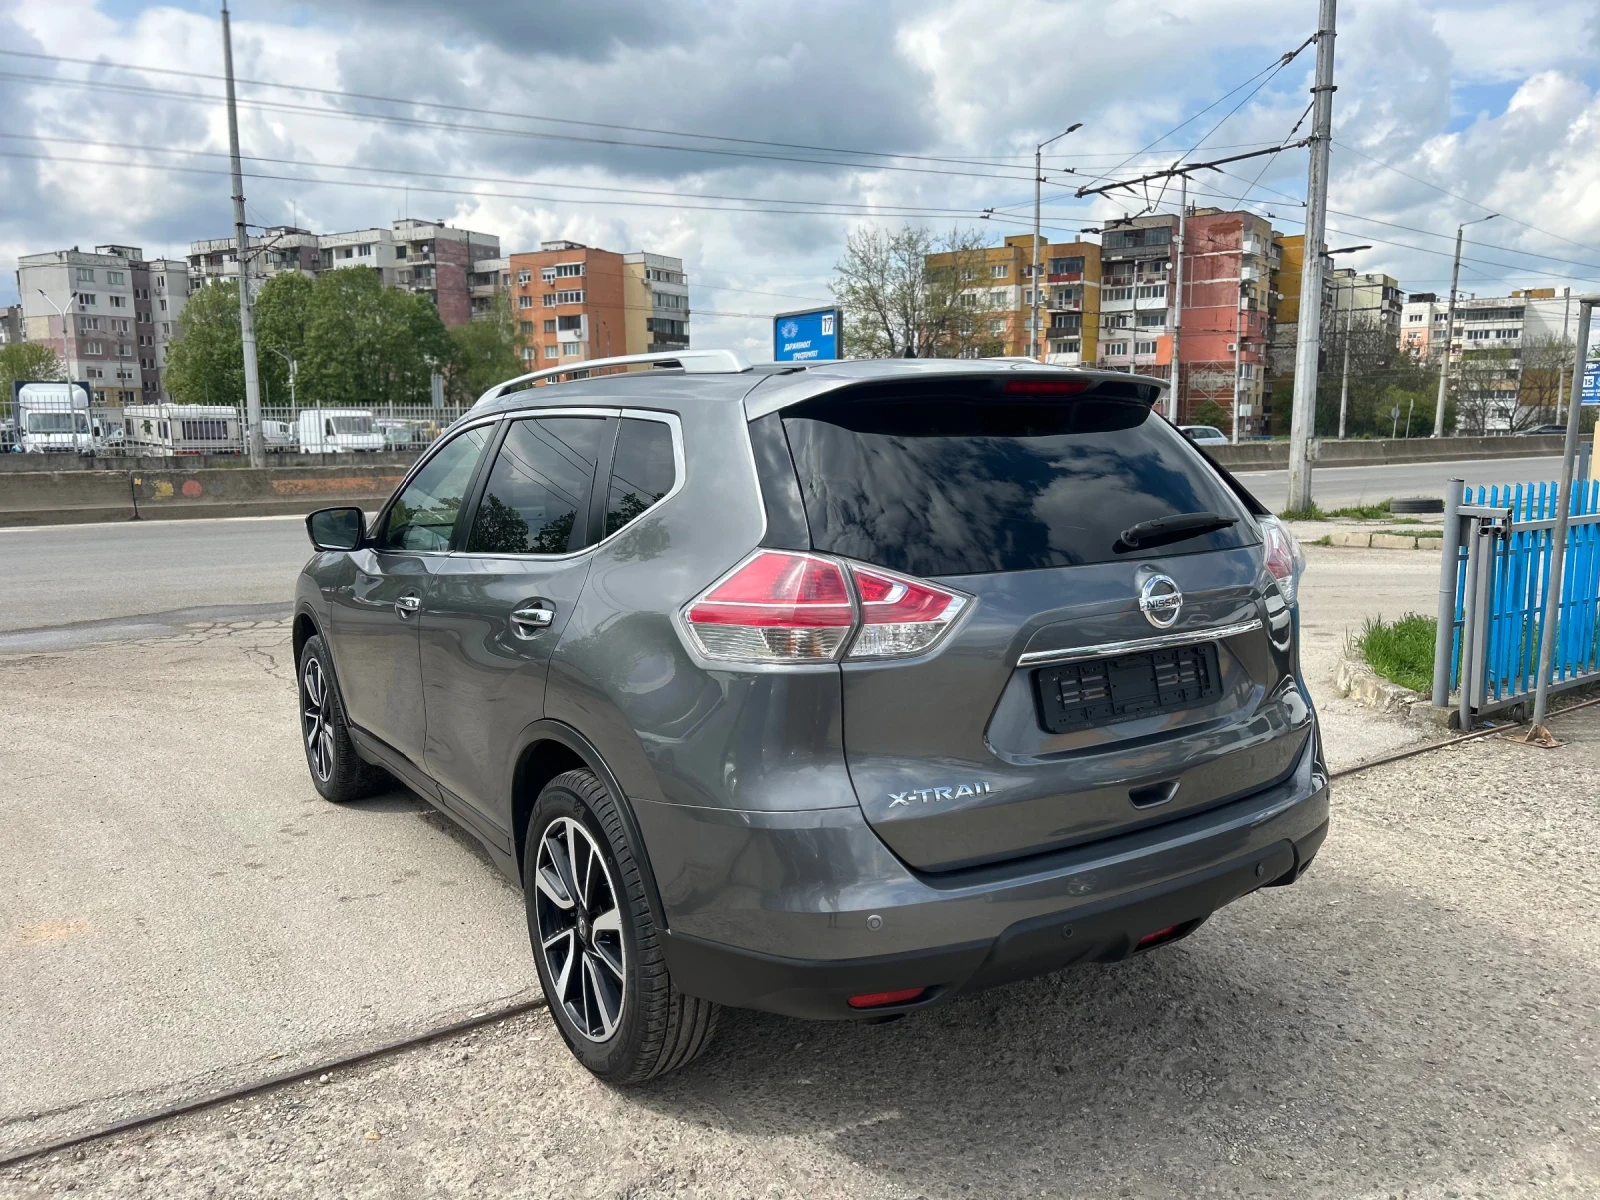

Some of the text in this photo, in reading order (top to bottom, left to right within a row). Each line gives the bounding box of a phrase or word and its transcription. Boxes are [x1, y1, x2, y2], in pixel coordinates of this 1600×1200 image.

[822, 317, 833, 333] 17
[1584, 378, 1593, 386] 15
[1146, 595, 1181, 609] NISSAN
[886, 781, 1002, 808] X-TRAIL
